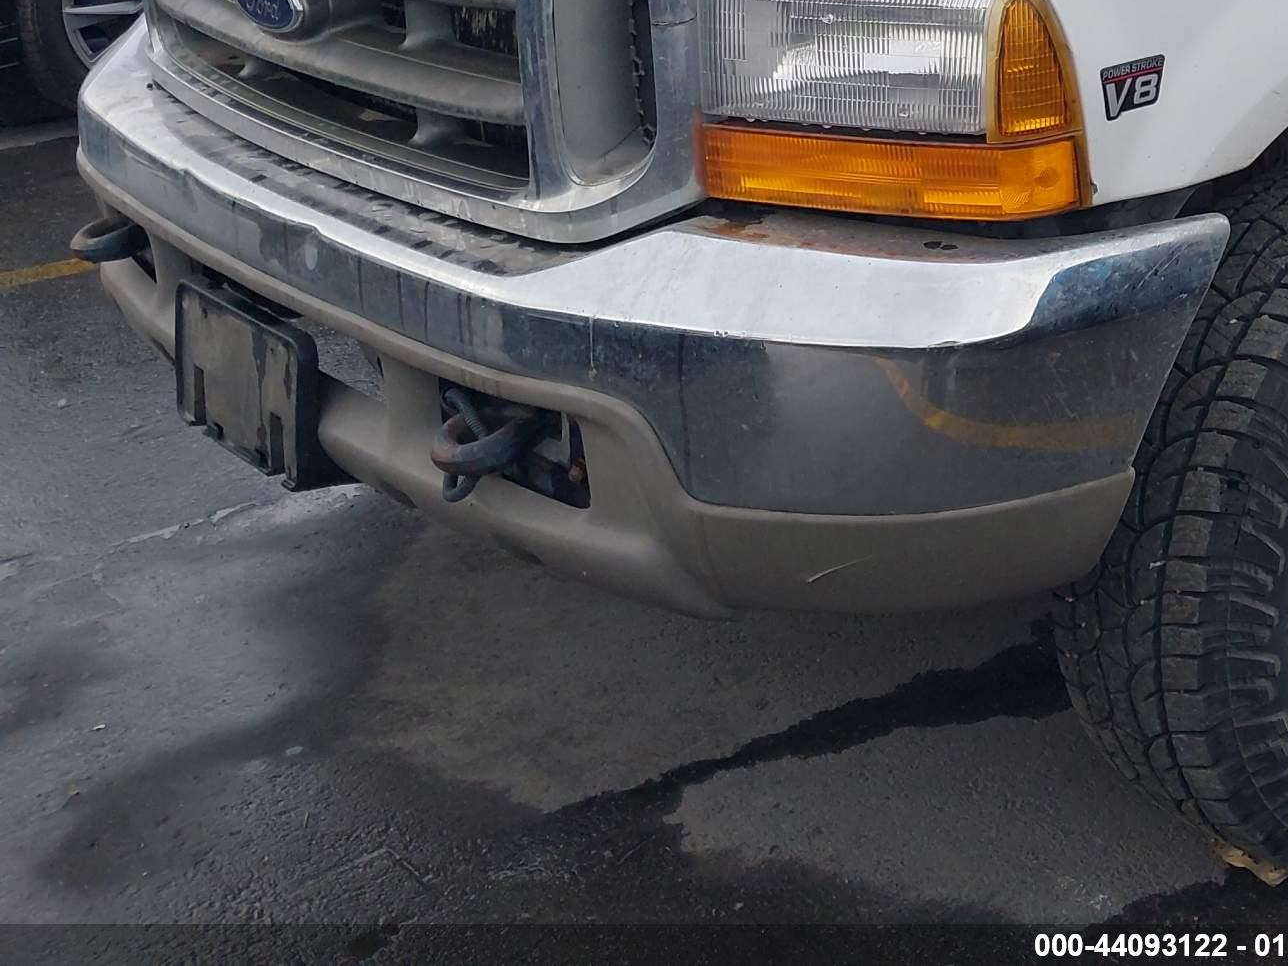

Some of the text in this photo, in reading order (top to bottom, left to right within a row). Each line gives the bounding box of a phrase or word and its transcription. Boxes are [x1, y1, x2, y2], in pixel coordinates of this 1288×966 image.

[1102, 57, 1164, 81] POWER STROKE
[1105, 73, 1159, 117] V8
